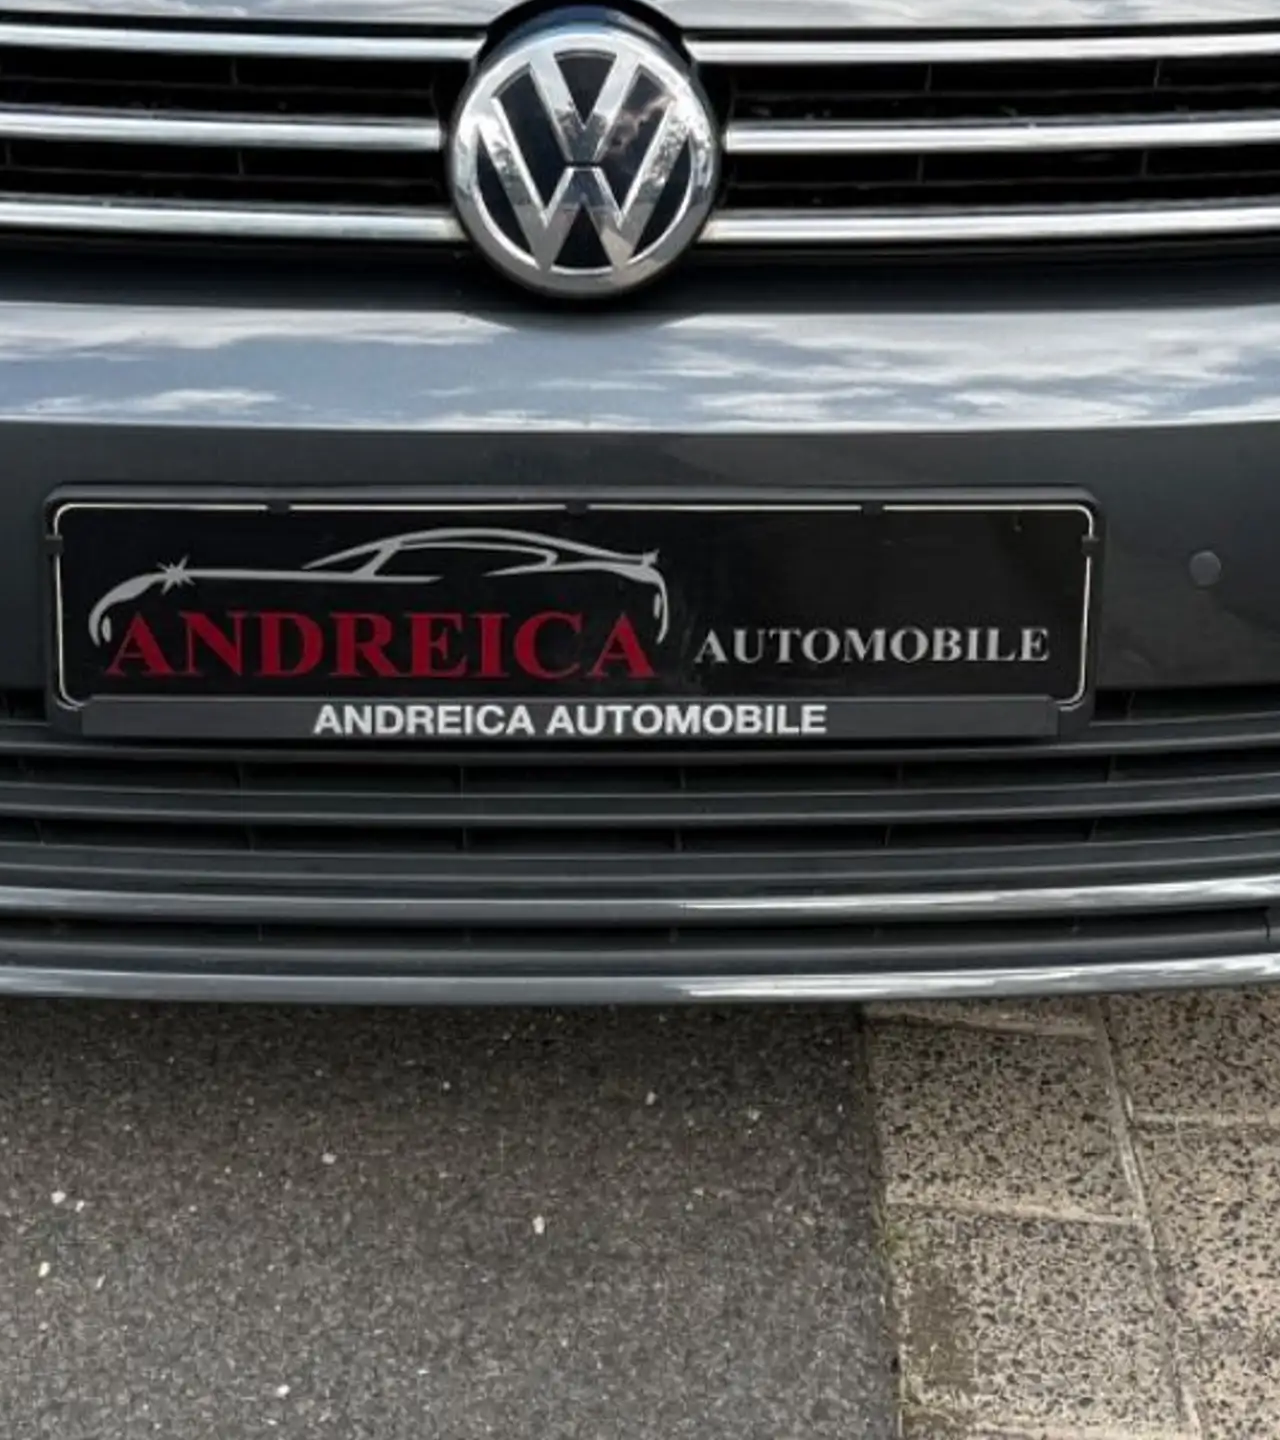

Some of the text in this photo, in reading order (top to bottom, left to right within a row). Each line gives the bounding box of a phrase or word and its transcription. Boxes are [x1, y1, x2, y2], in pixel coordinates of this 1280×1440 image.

[104, 610, 1051, 679] ANDREICA AUTOMOBILE
[312, 703, 828, 736] ANDREICA AUTOMOBILE
